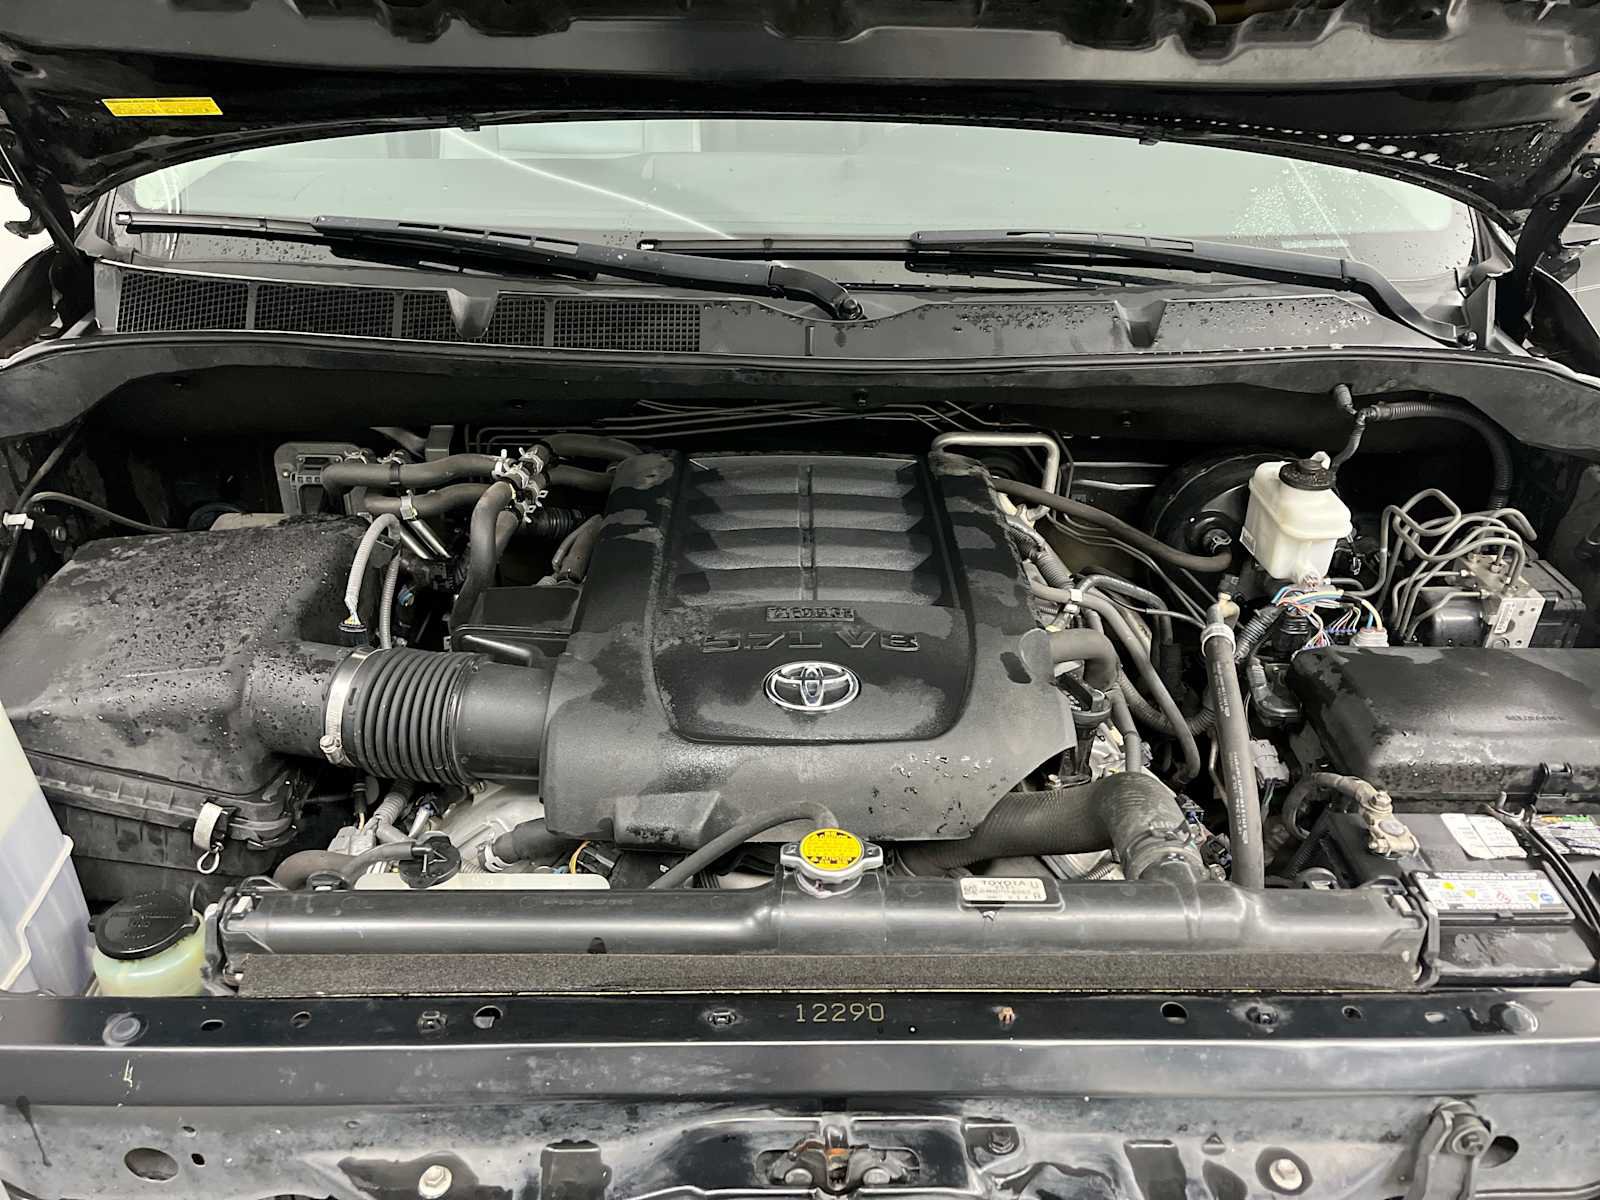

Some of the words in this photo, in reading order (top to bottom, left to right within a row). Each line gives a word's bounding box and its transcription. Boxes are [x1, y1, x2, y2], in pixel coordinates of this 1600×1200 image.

[703, 631, 823, 653] 5.7L
[836, 631, 921, 652] V8
[795, 1002, 885, 1022] 12290
